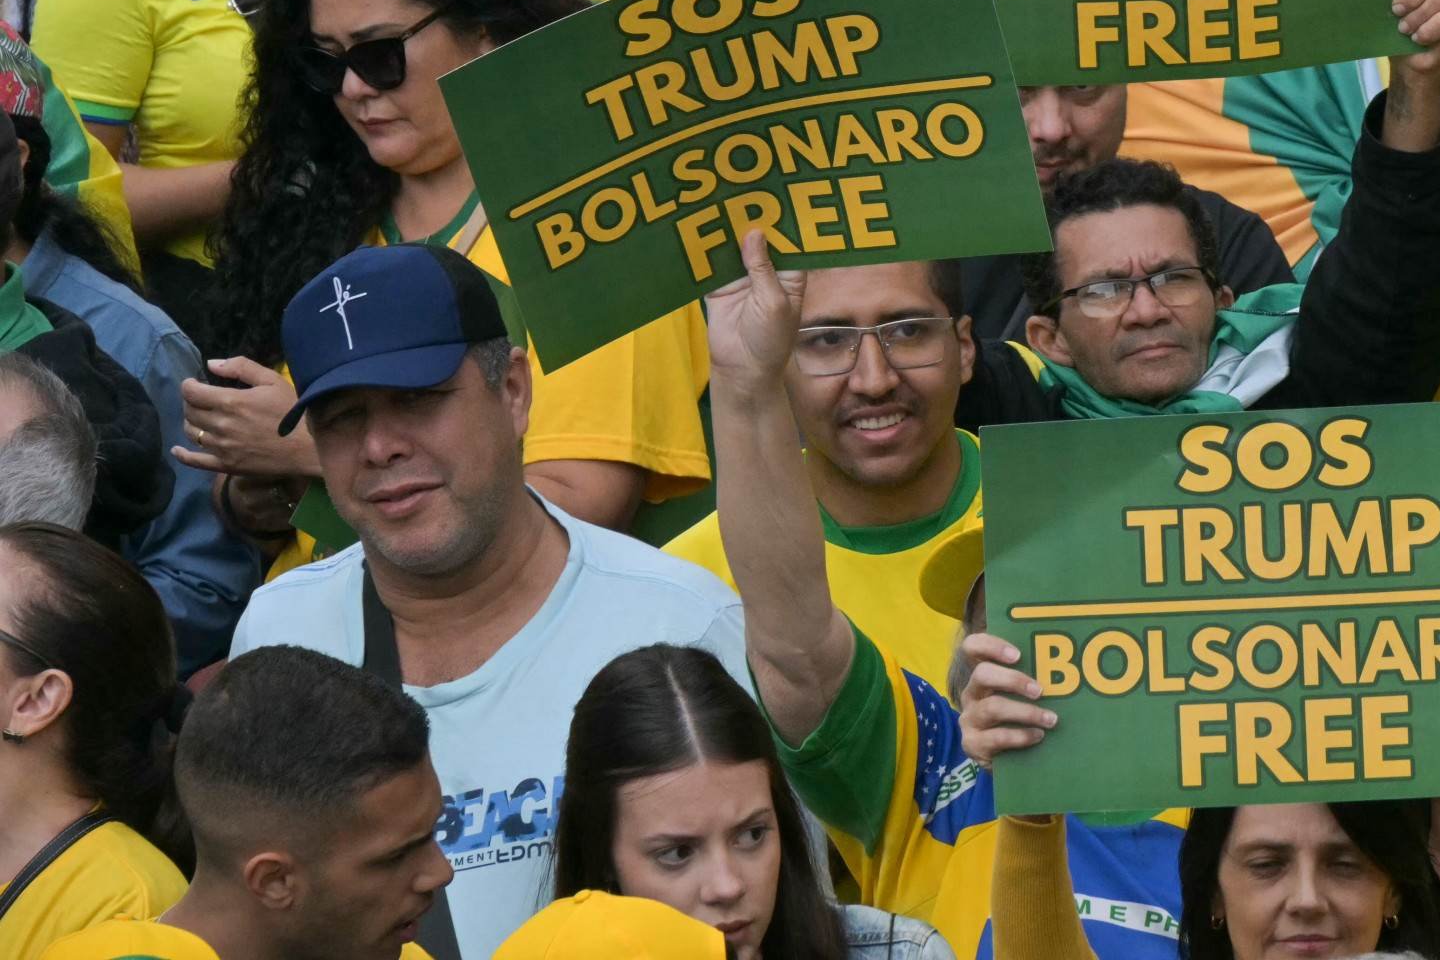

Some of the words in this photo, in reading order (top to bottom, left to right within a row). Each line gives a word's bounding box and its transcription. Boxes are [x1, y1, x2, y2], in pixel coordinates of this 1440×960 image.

[584, 13, 880, 142] TRUMP
[535, 102, 986, 271] BOLSONARO
[676, 173, 897, 283] FREE
[1177, 417, 1372, 494] SOS
[1177, 693, 1414, 787] FREE
